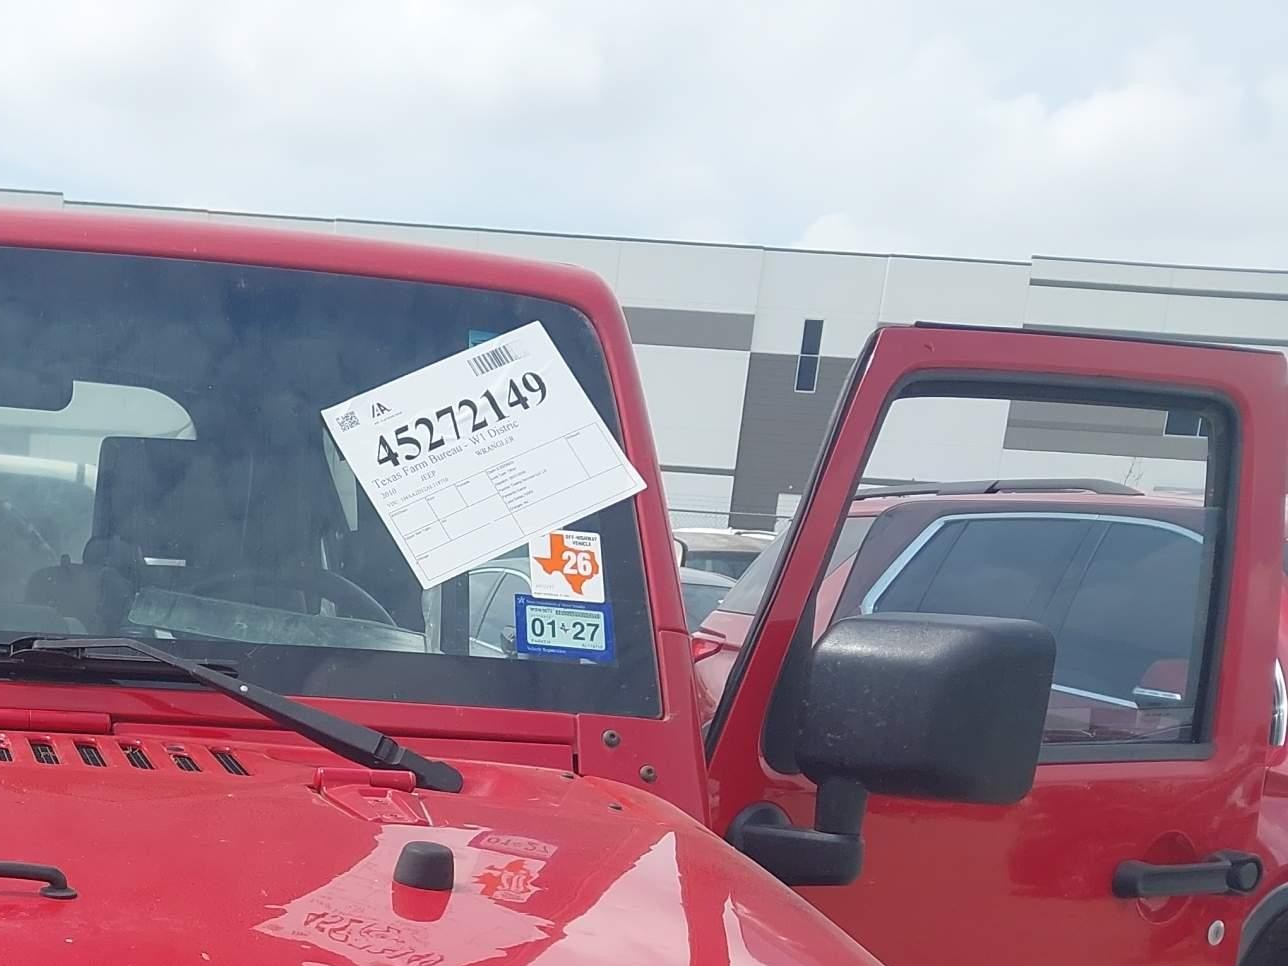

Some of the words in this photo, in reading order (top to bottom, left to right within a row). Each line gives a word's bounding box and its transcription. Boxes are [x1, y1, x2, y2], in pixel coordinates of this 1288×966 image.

[376, 371, 548, 468] 45272149
[475, 436, 514, 457] WRANGLER
[372, 468, 403, 489] Texas
[402, 458, 429, 476] Farm
[429, 446, 463, 465] Bureau
[561, 550, 593, 577] 26
[531, 618, 557, 638] 01
[572, 621, 600, 642] 27
